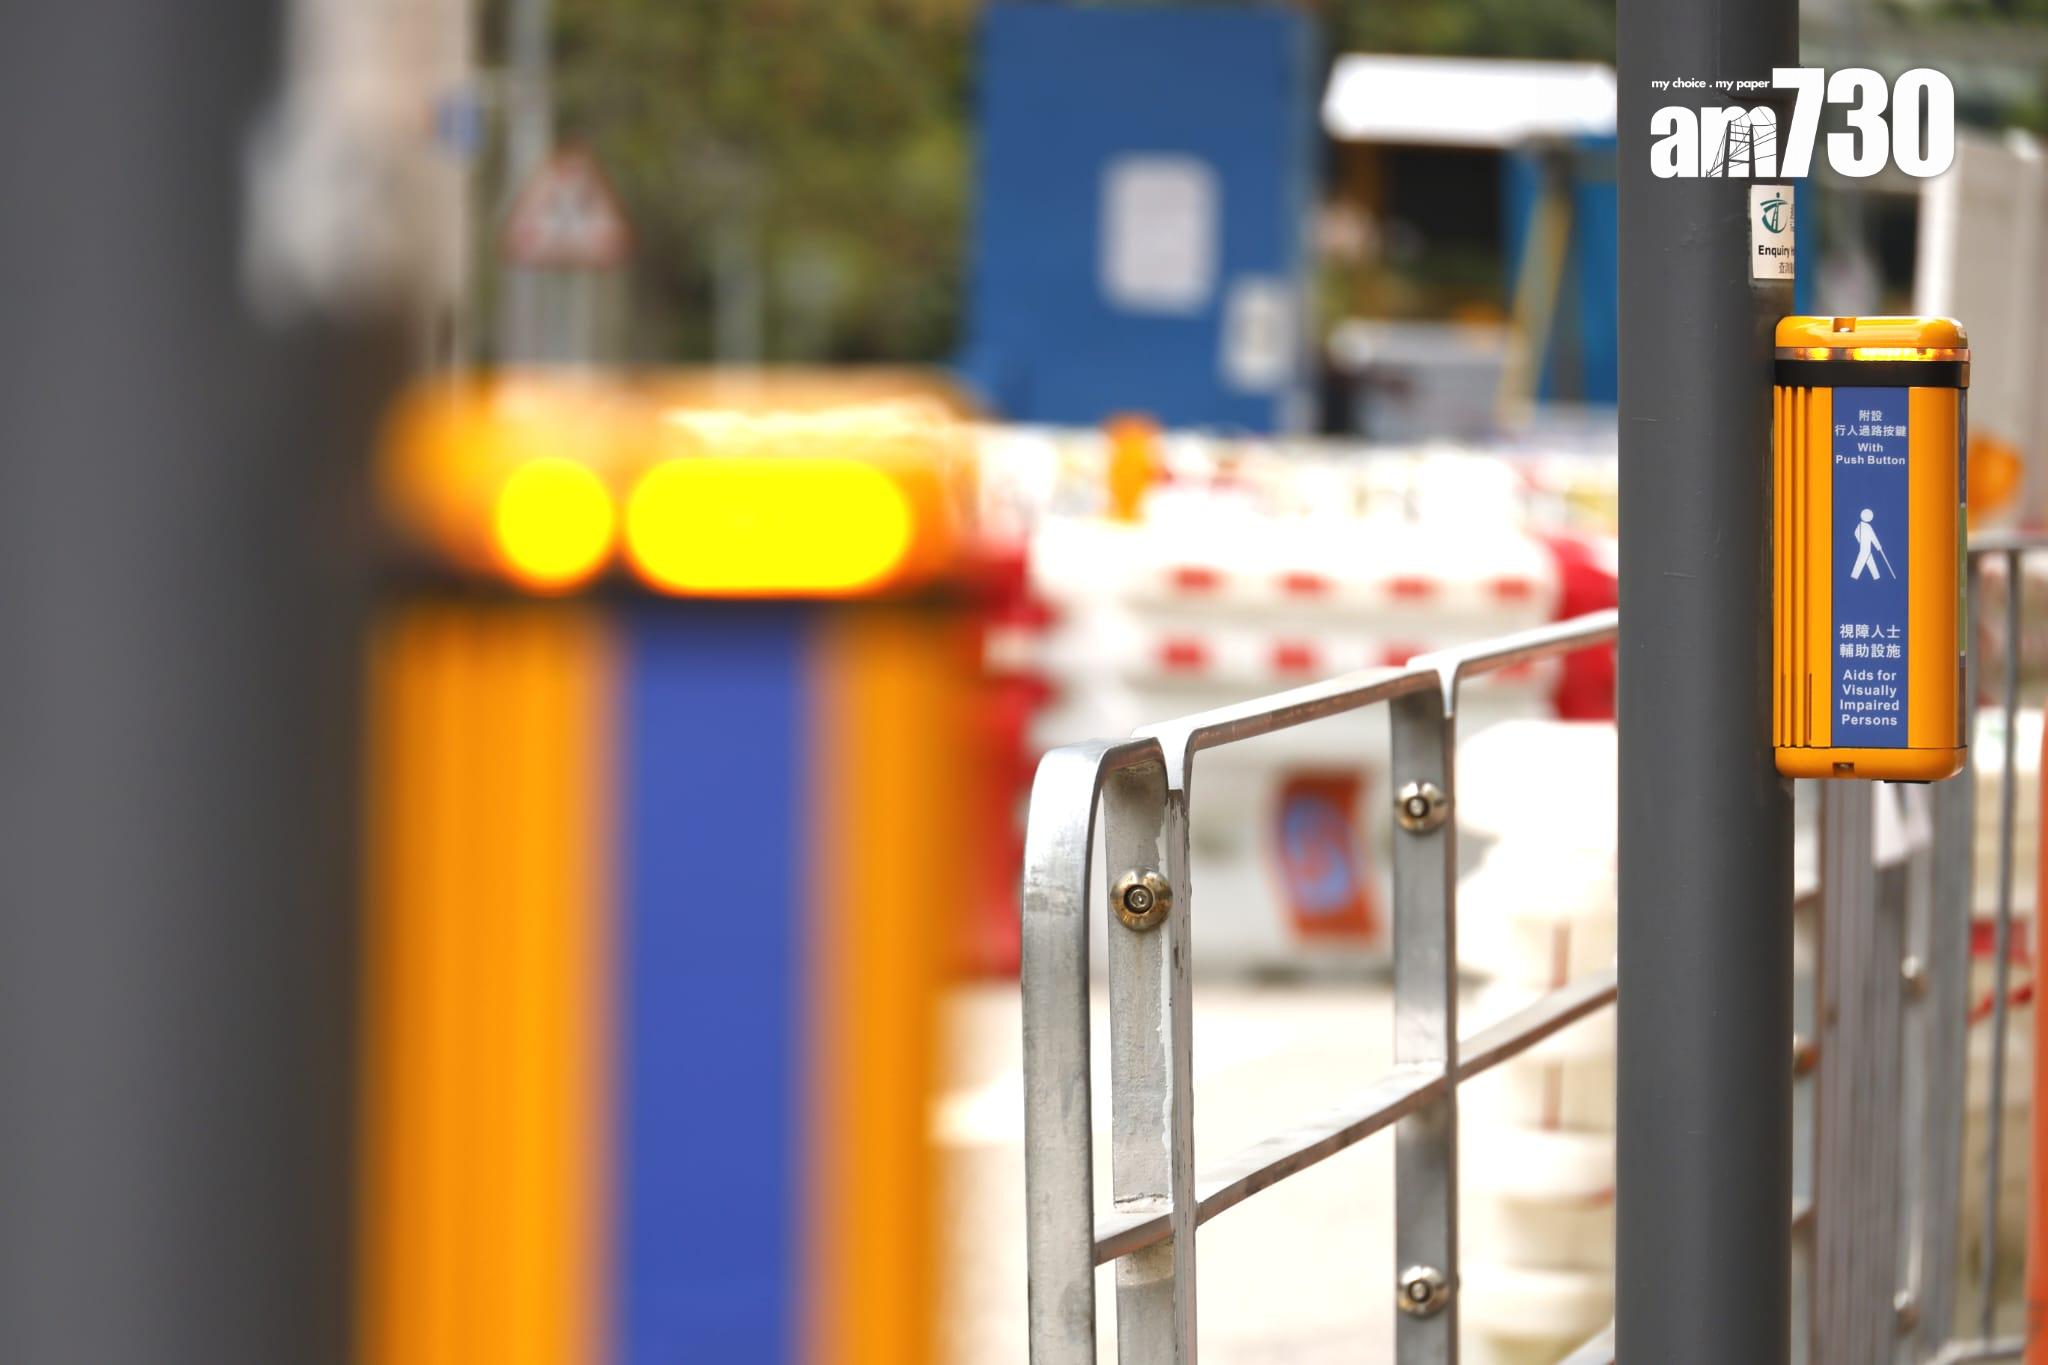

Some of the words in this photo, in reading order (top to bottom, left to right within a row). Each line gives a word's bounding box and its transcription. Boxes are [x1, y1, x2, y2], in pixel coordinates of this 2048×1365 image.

[1858, 409, 1883, 422] 附設
[1834, 424, 1907, 437] 行人過路按鍵
[1857, 442, 1884, 453] With
[1835, 455, 1864, 465] Push
[1867, 455, 1906, 465] Button
[1839, 624, 1901, 639] 視障人士
[1839, 643, 1901, 658] 輔助設施
[1842, 669, 1874, 681] Aids
[1877, 669, 1897, 681] for
[1842, 684, 1897, 698] Visually
[1840, 699, 1900, 712] Impaired
[1841, 714, 1898, 726] Persons
